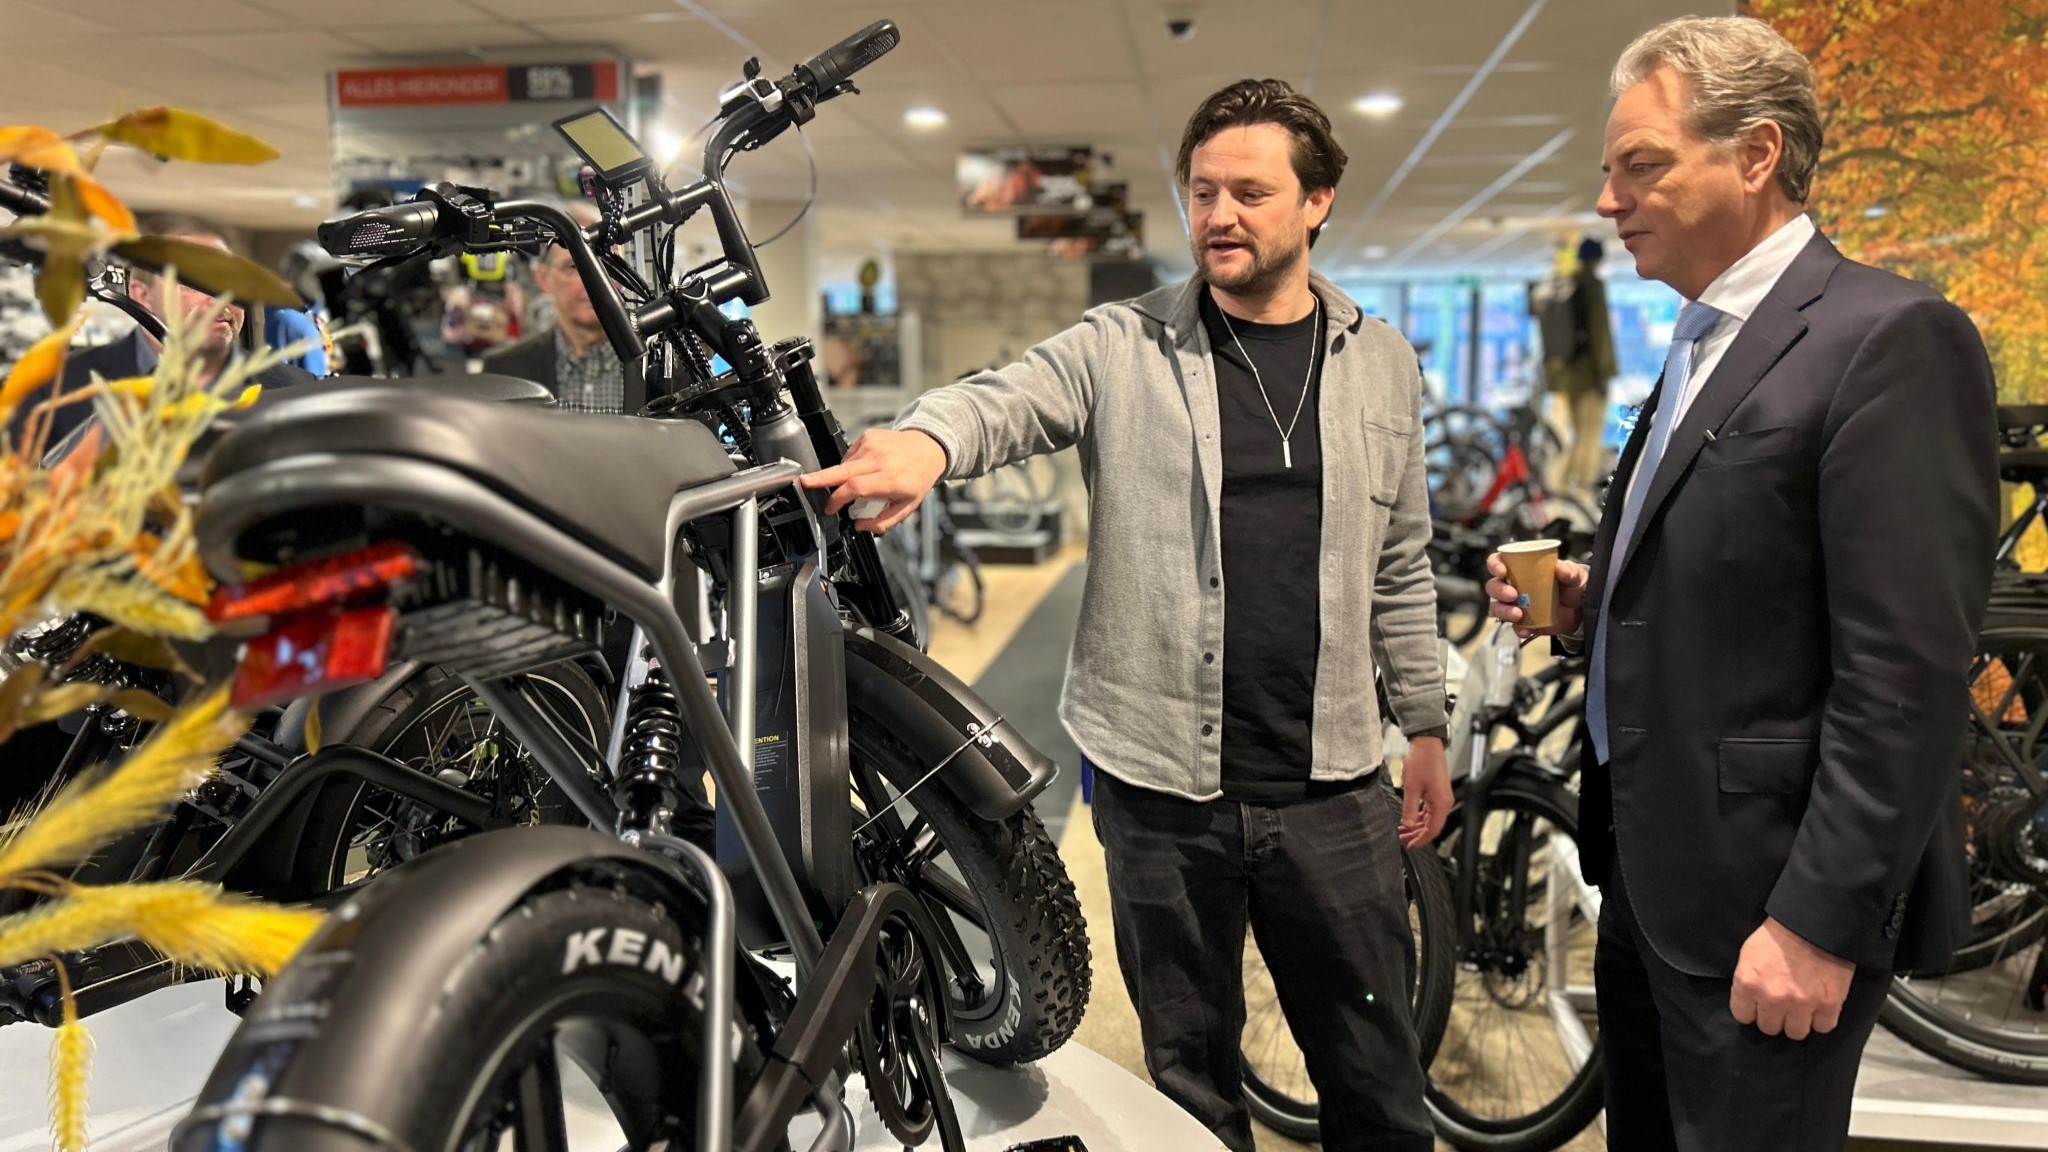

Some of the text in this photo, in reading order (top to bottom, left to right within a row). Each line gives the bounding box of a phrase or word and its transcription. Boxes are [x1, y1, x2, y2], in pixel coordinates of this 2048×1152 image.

[344, 77, 395, 98] ALLES
[754, 735, 779, 744] ENTION
[965, 967, 1021, 1049] KENDA
